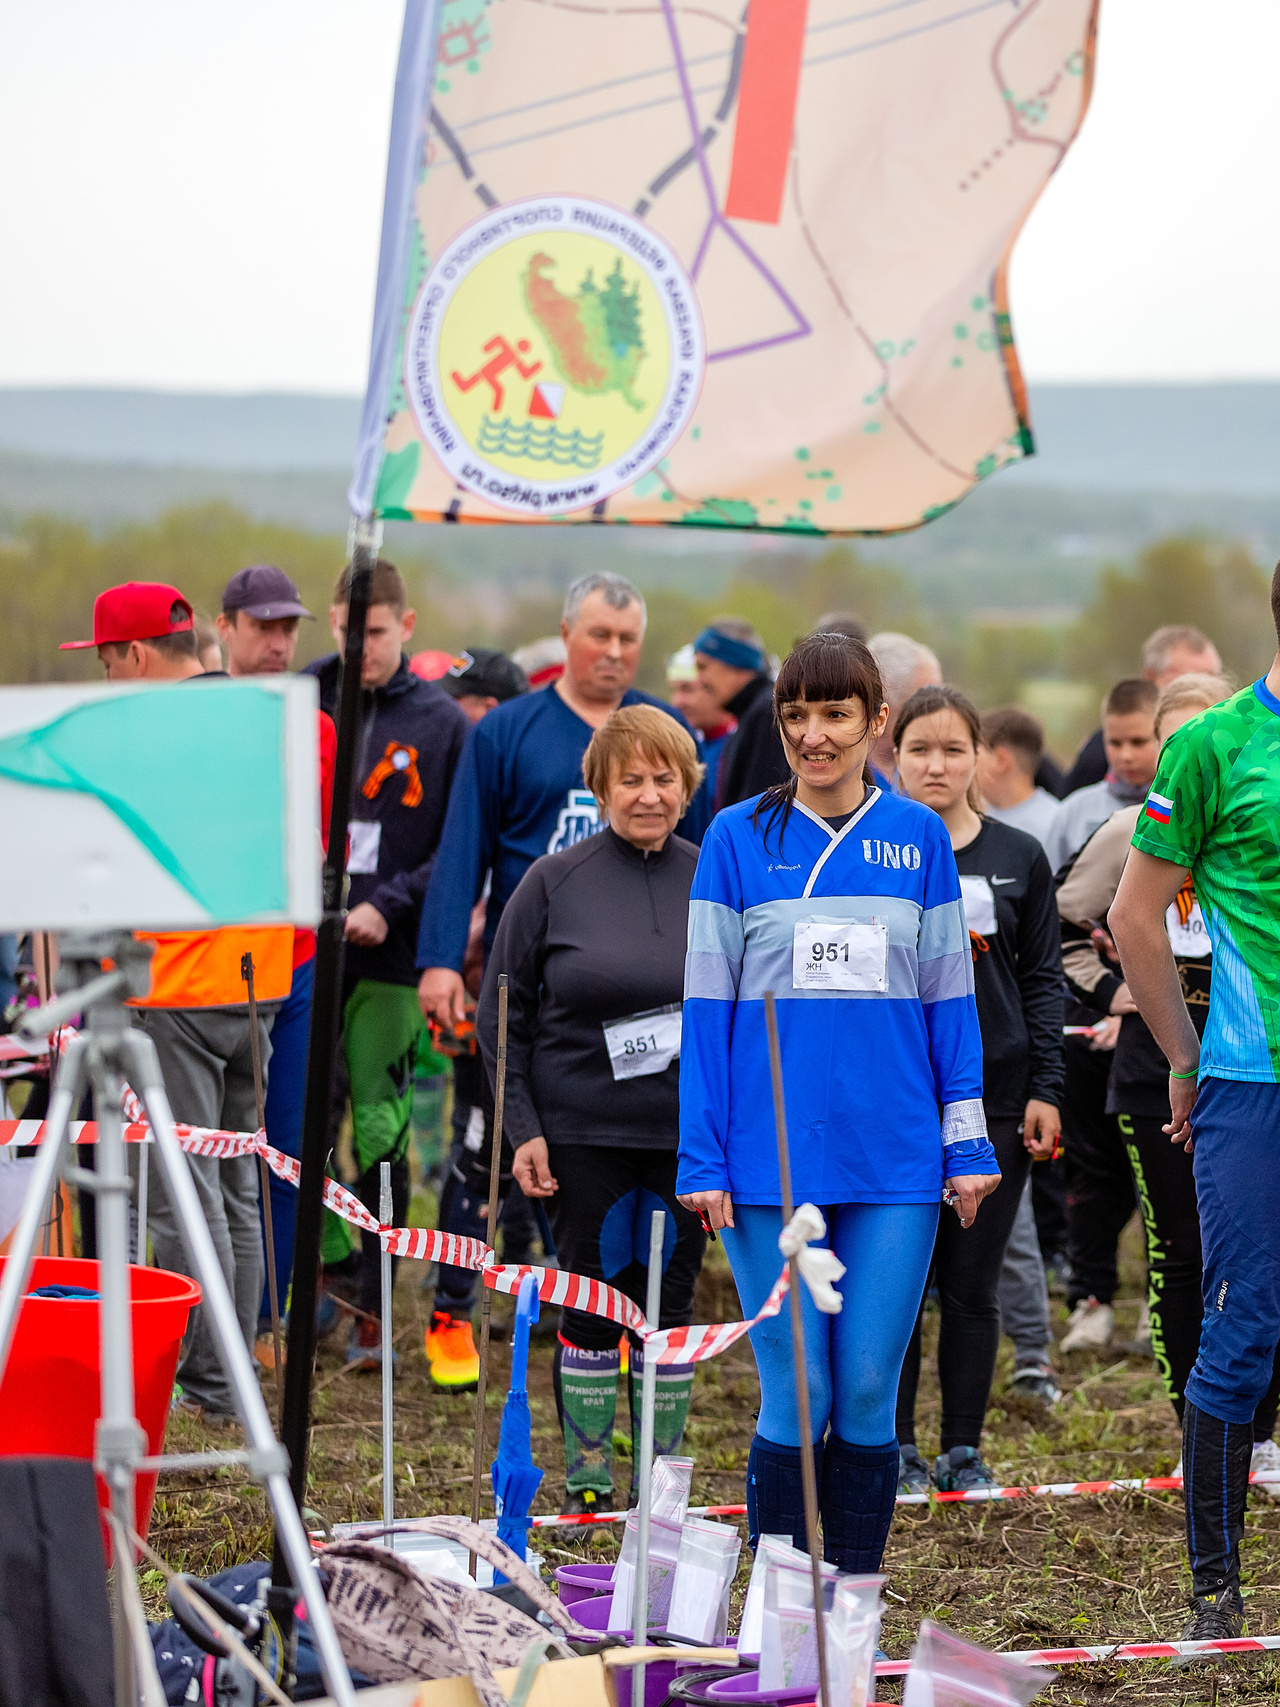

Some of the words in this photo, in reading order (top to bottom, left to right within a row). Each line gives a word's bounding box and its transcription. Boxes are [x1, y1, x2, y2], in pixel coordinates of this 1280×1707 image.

[862, 839, 921, 871] UNO
[811, 942, 850, 963] 951
[805, 962, 822, 971] ЖН
[624, 1033, 657, 1056] 851
[1126, 1143, 1167, 1262] SPECIAL
[1147, 1270, 1180, 1400] FASHION
[582, 1396, 605, 1406] КРАЙ
